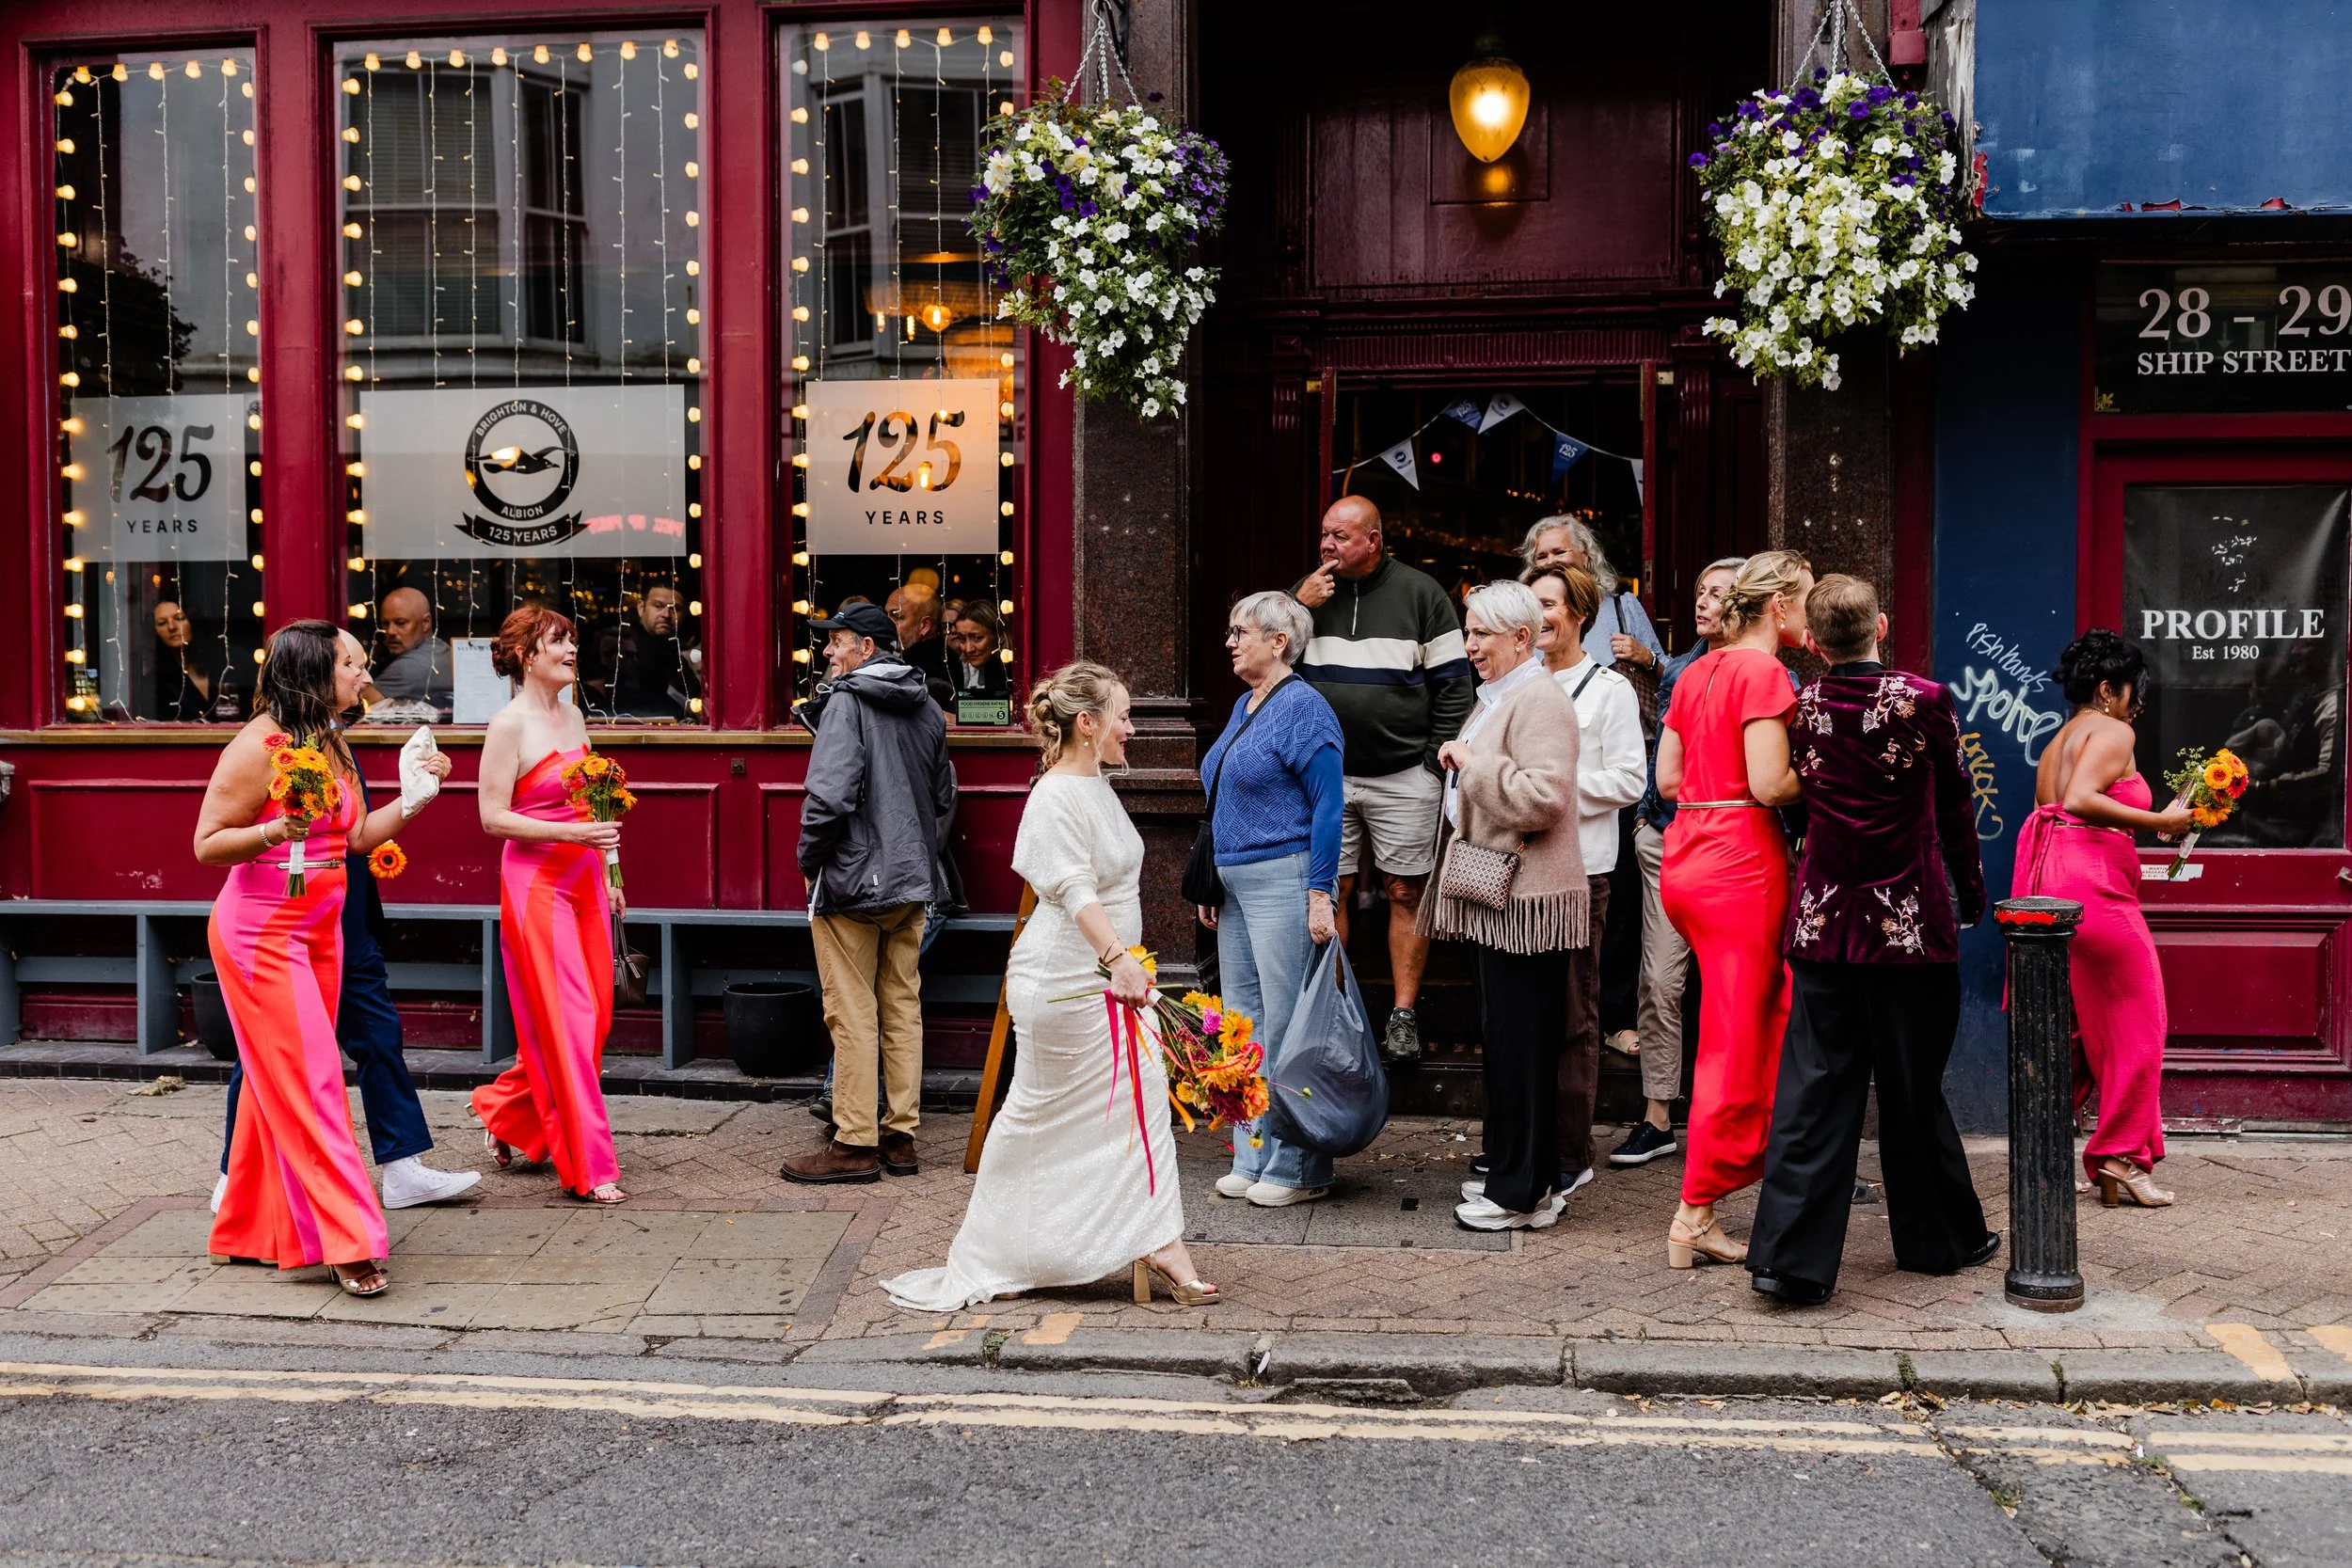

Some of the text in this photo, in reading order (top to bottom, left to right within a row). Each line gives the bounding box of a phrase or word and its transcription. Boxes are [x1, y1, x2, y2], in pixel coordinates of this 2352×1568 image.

[2138, 287, 2211, 341] 28
[2278, 284, 2352, 338] 29
[2137, 349, 2352, 375] SHIP STREET
[475, 402, 567, 436] BRIGHTON & HOVE
[843, 410, 965, 493] 125
[1559, 443, 1578, 458] 125
[104, 423, 215, 503] 125
[501, 505, 544, 518] ALBION
[865, 510, 944, 525] YEARS
[126, 519, 198, 533] YEARS
[488, 525, 558, 543] 125 YEARS
[2140, 609, 2325, 640] PROFILE
[2192, 644, 2260, 660] Est 1980
